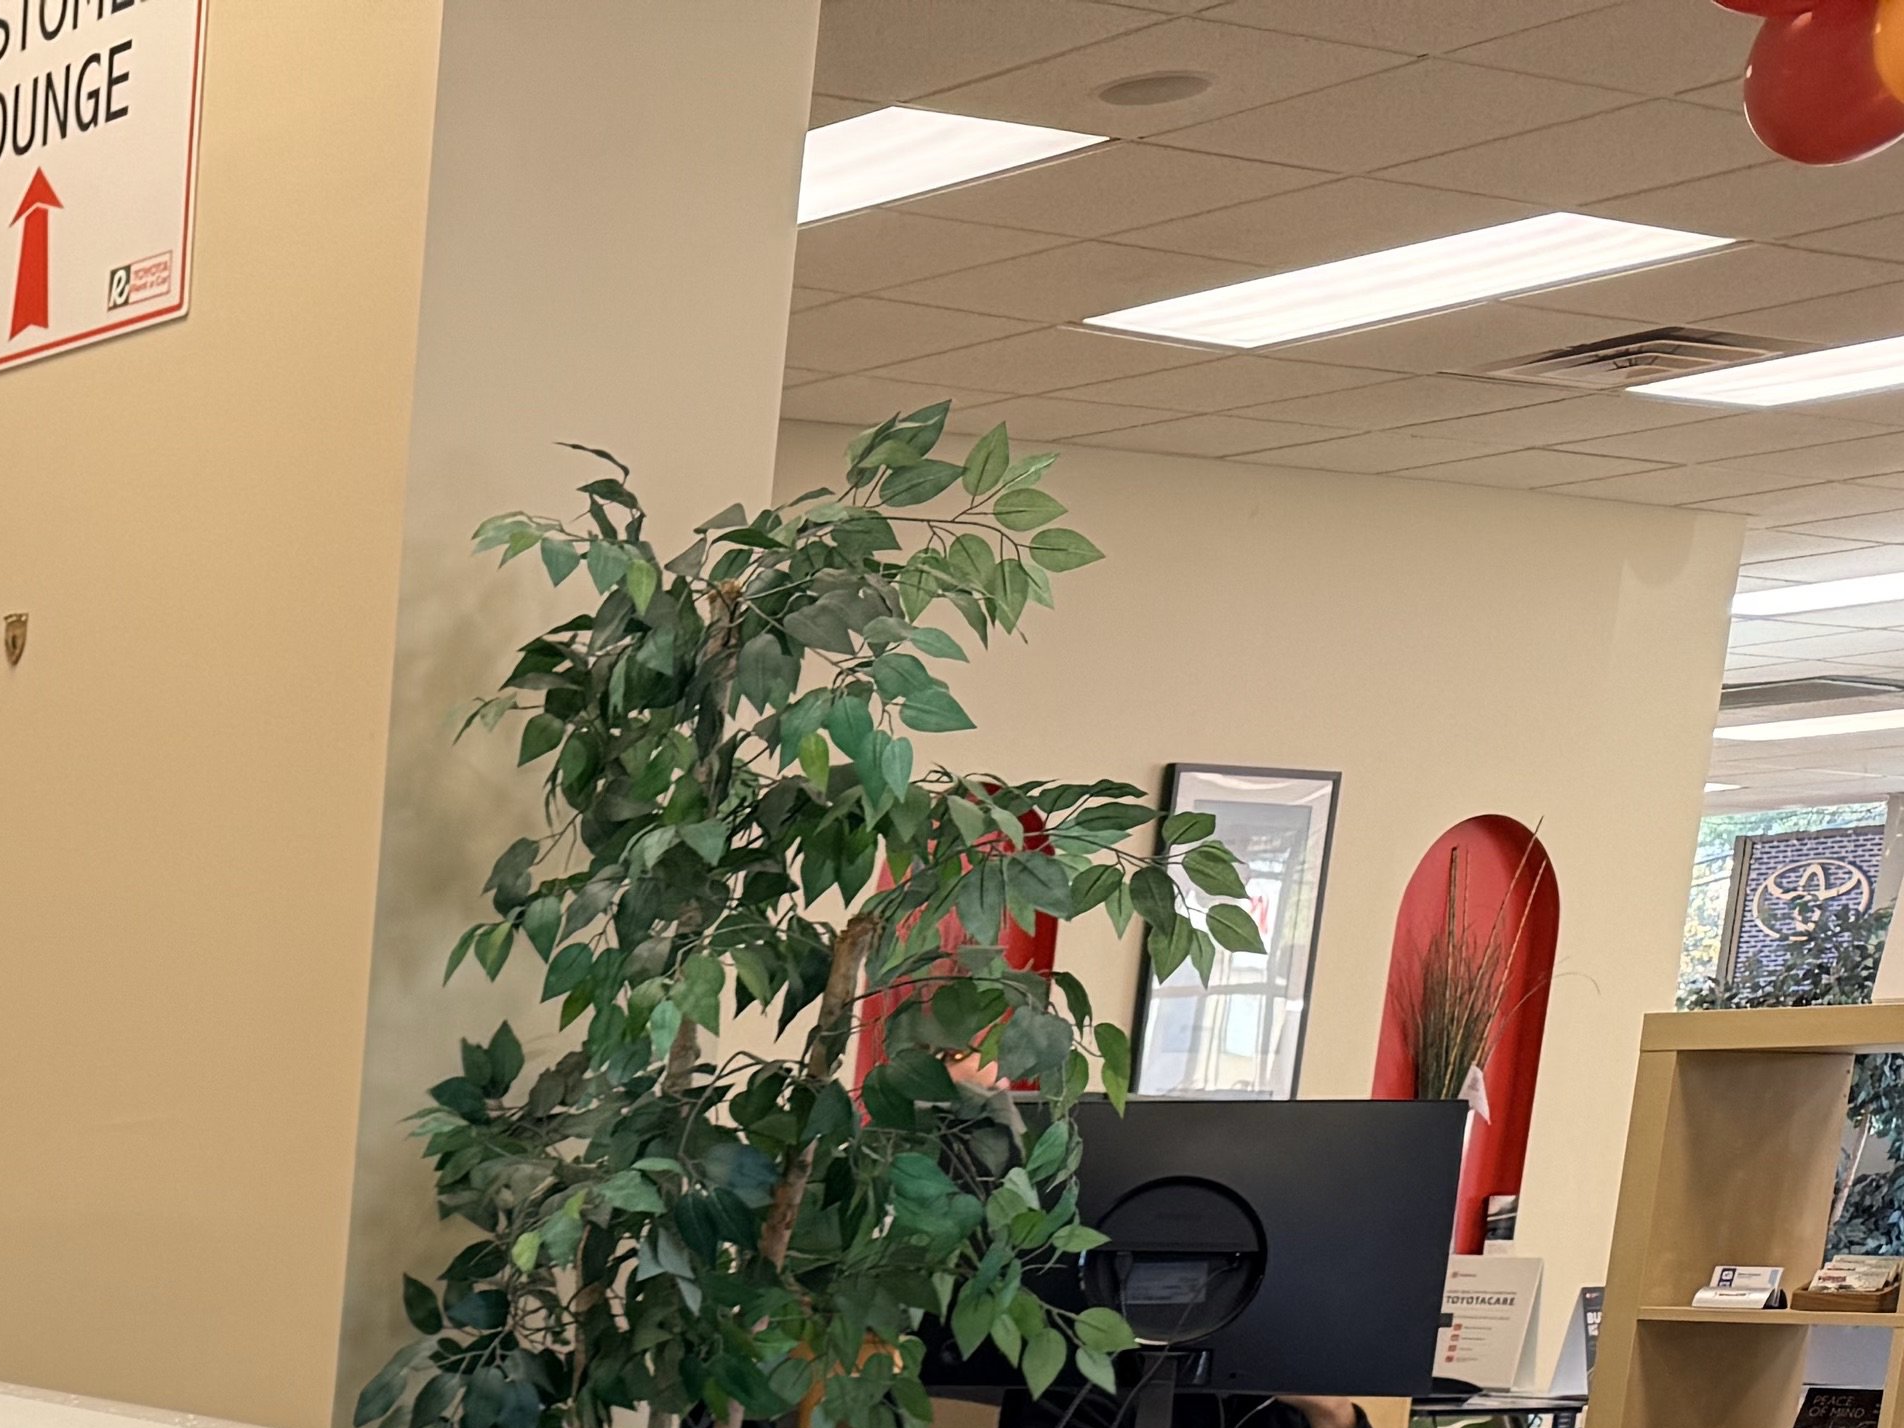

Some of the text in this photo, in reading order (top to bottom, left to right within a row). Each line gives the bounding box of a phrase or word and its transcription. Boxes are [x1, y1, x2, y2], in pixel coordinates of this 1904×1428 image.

[1813, 1395, 1855, 1407] PEACE
[1808, 1406, 1865, 1419] OF MIND
